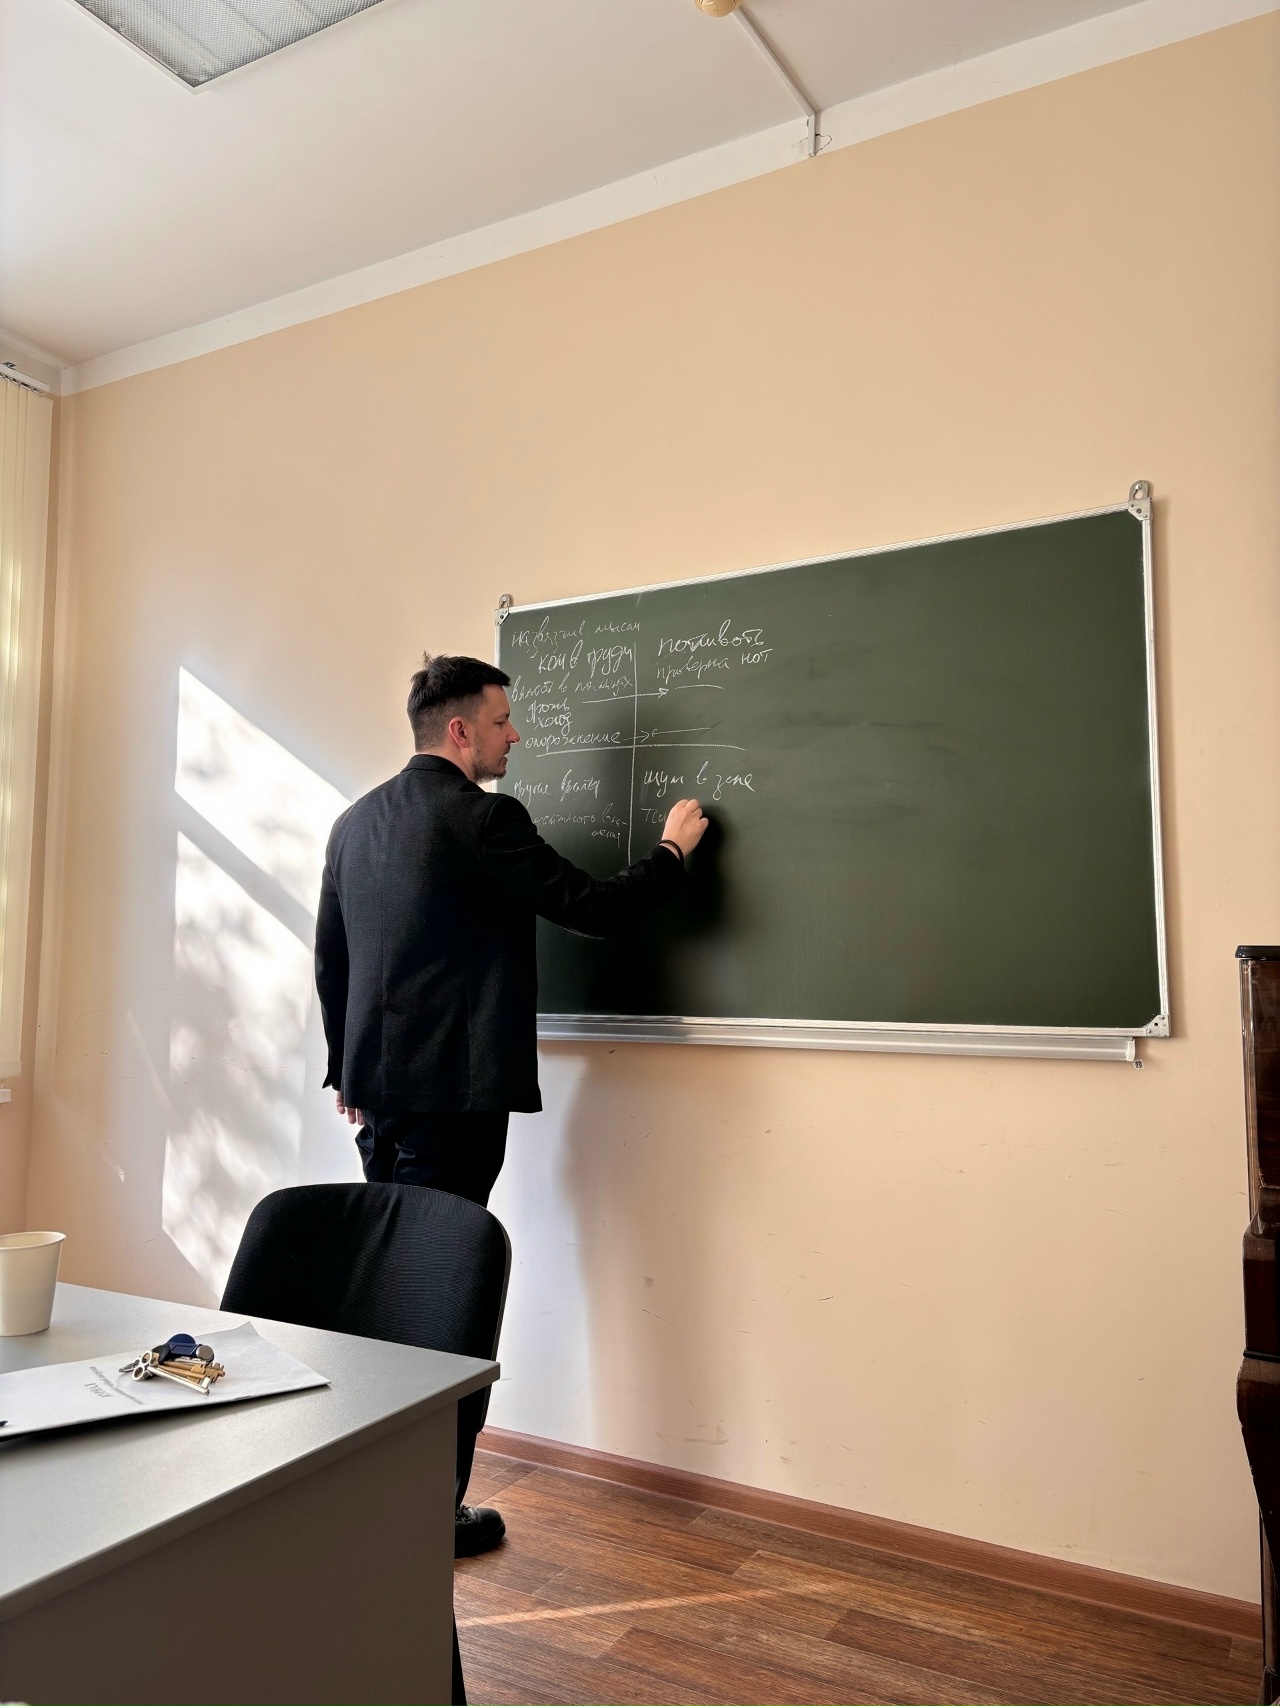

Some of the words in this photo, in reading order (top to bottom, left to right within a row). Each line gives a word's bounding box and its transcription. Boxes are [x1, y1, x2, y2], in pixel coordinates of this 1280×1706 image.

[569, 639, 585, 669] в
[740, 648, 774, 665] нот
[695, 760, 710, 786] в
